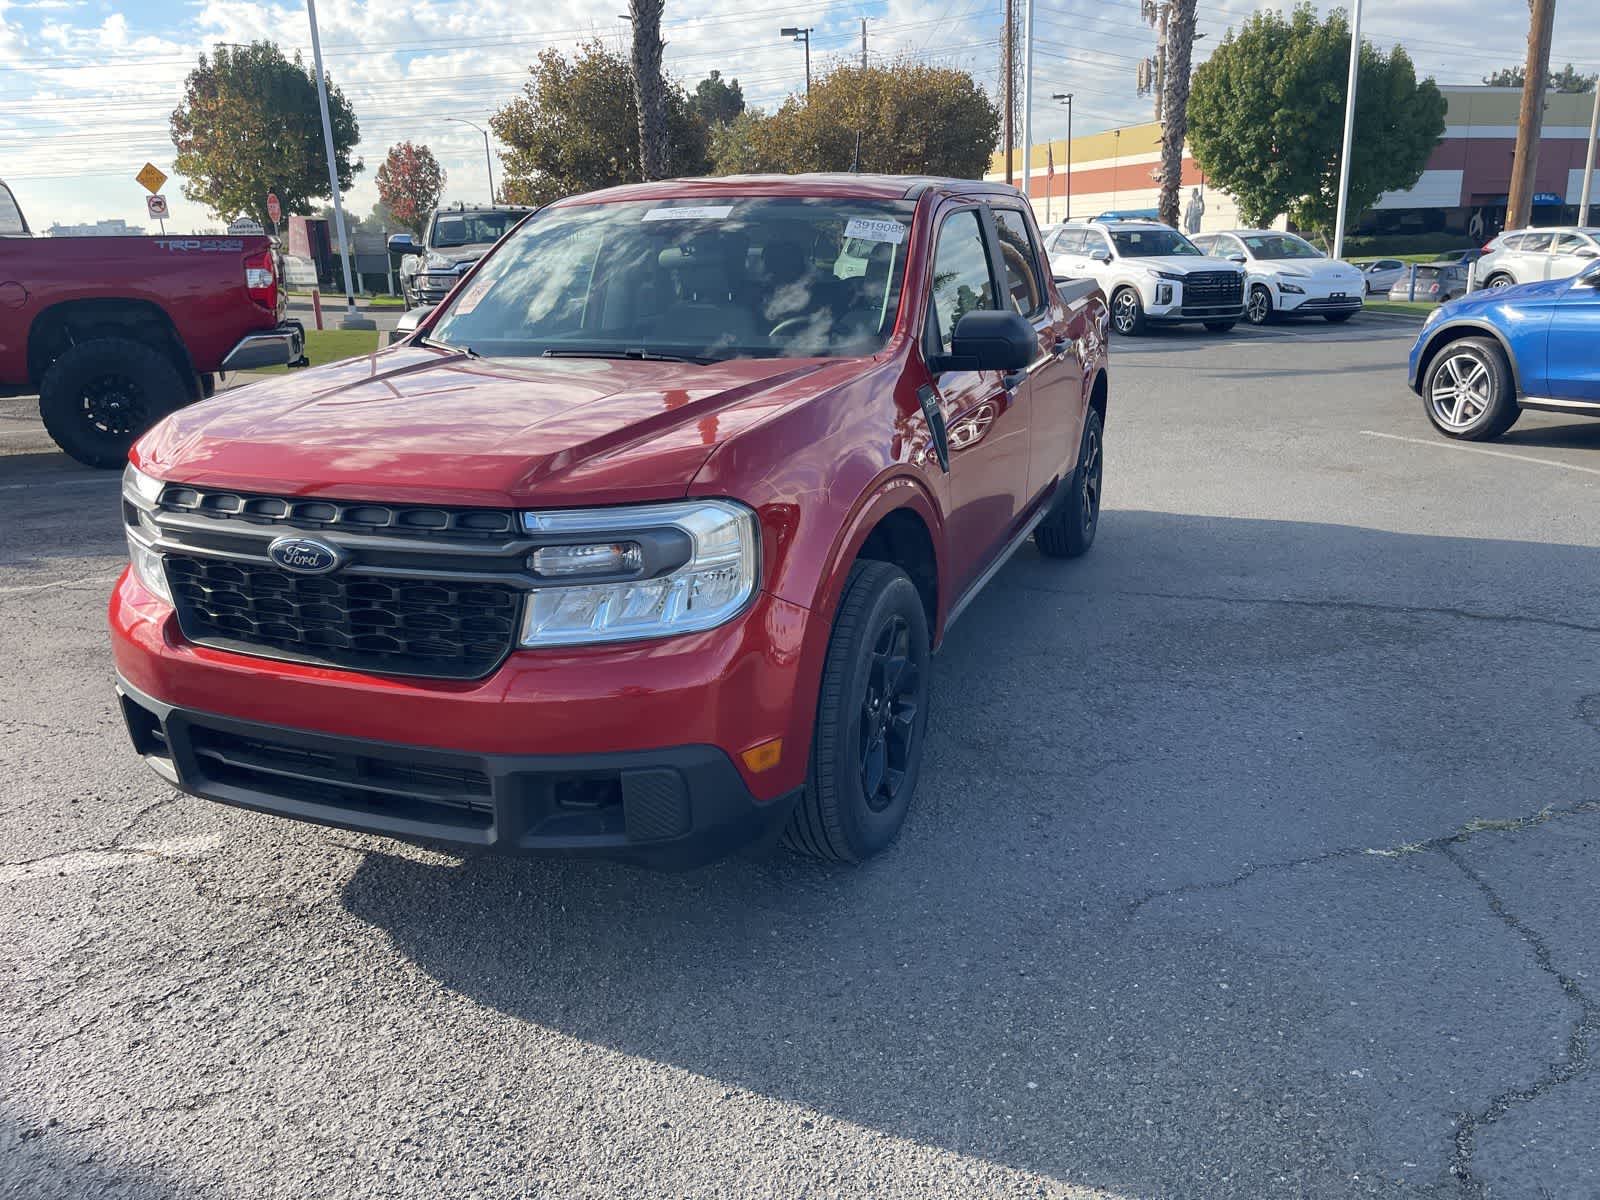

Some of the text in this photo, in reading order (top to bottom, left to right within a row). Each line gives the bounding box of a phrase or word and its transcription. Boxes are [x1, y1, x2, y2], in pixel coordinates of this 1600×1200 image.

[855, 220, 905, 234] 3919089
[154, 240, 200, 252] TRD
[283, 546, 319, 567] Ford
